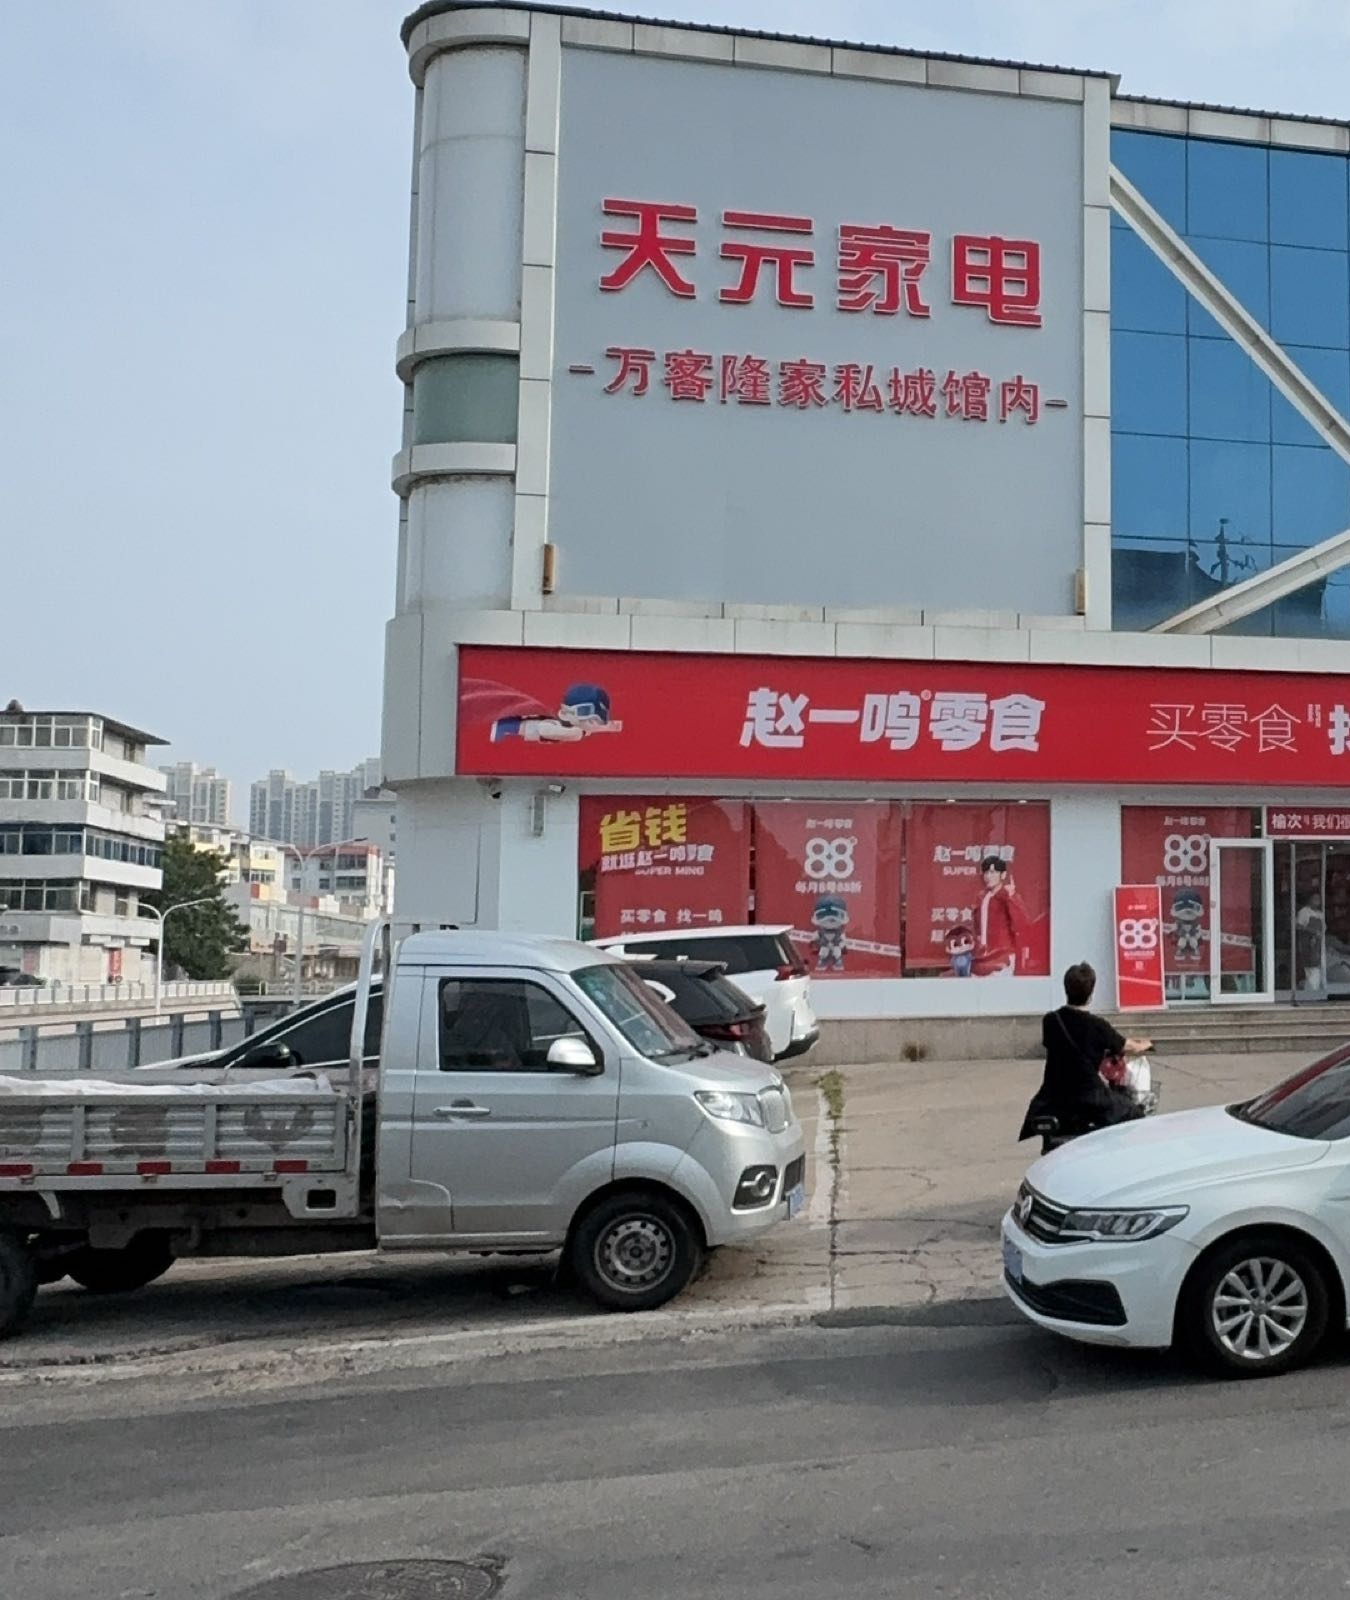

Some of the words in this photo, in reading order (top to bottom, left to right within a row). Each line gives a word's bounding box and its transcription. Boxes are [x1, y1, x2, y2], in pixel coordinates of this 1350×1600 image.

[600, 197, 1042, 328] 天元家电
[739, 687, 1046, 752] 赵一鸣零食
[1146, 703, 1302, 752] 买零食
[600, 803, 687, 853] 省钱
[804, 837, 855, 879] 88
[1164, 834, 1207, 873] 88
[1119, 919, 1157, 949] 88
